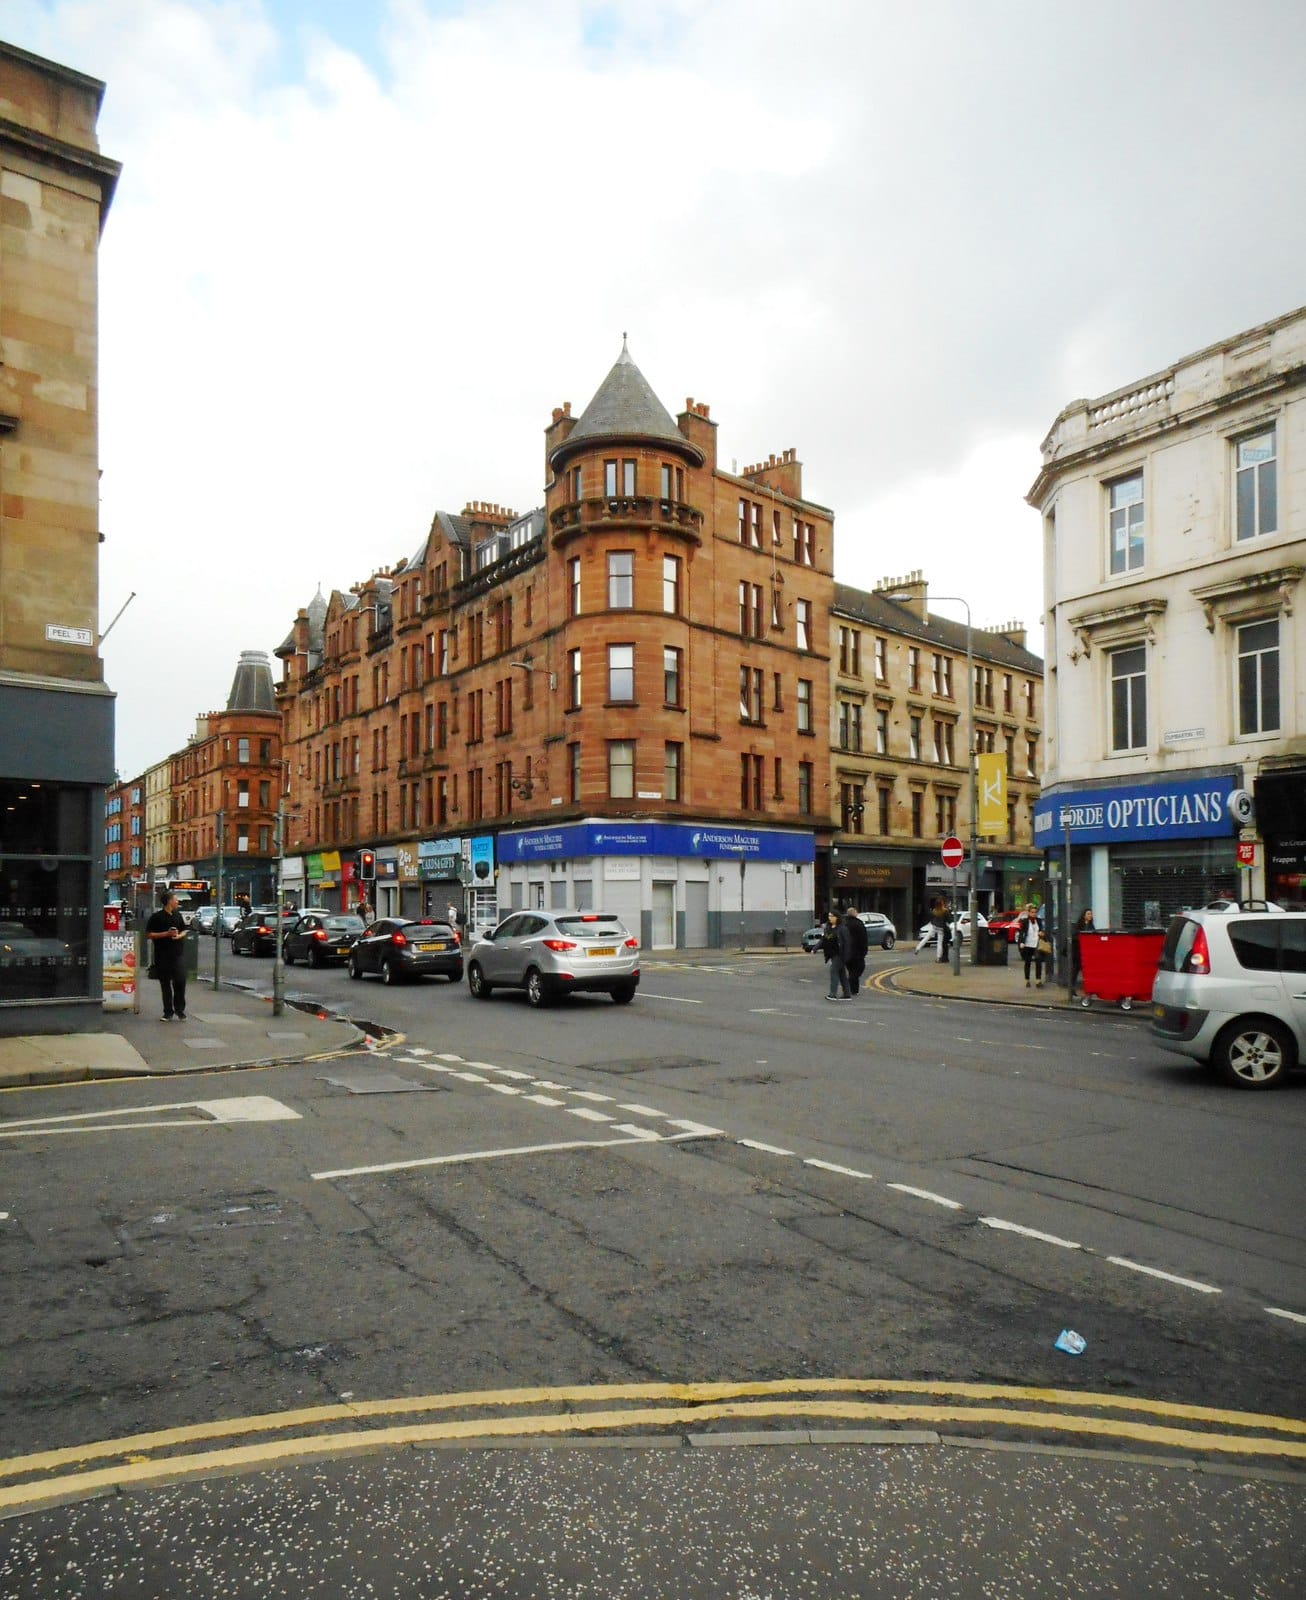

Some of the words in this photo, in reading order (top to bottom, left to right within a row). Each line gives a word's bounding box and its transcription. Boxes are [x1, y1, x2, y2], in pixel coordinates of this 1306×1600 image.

[52, 629, 70, 637] PEEL
[77, 632, 86, 640] ST
[1107, 791, 1222, 828] OPTICIANS
[702, 833, 733, 843] ANDERSON
[734, 835, 759, 845] MAGUIRE
[103, 943, 134, 951] LUNCH
